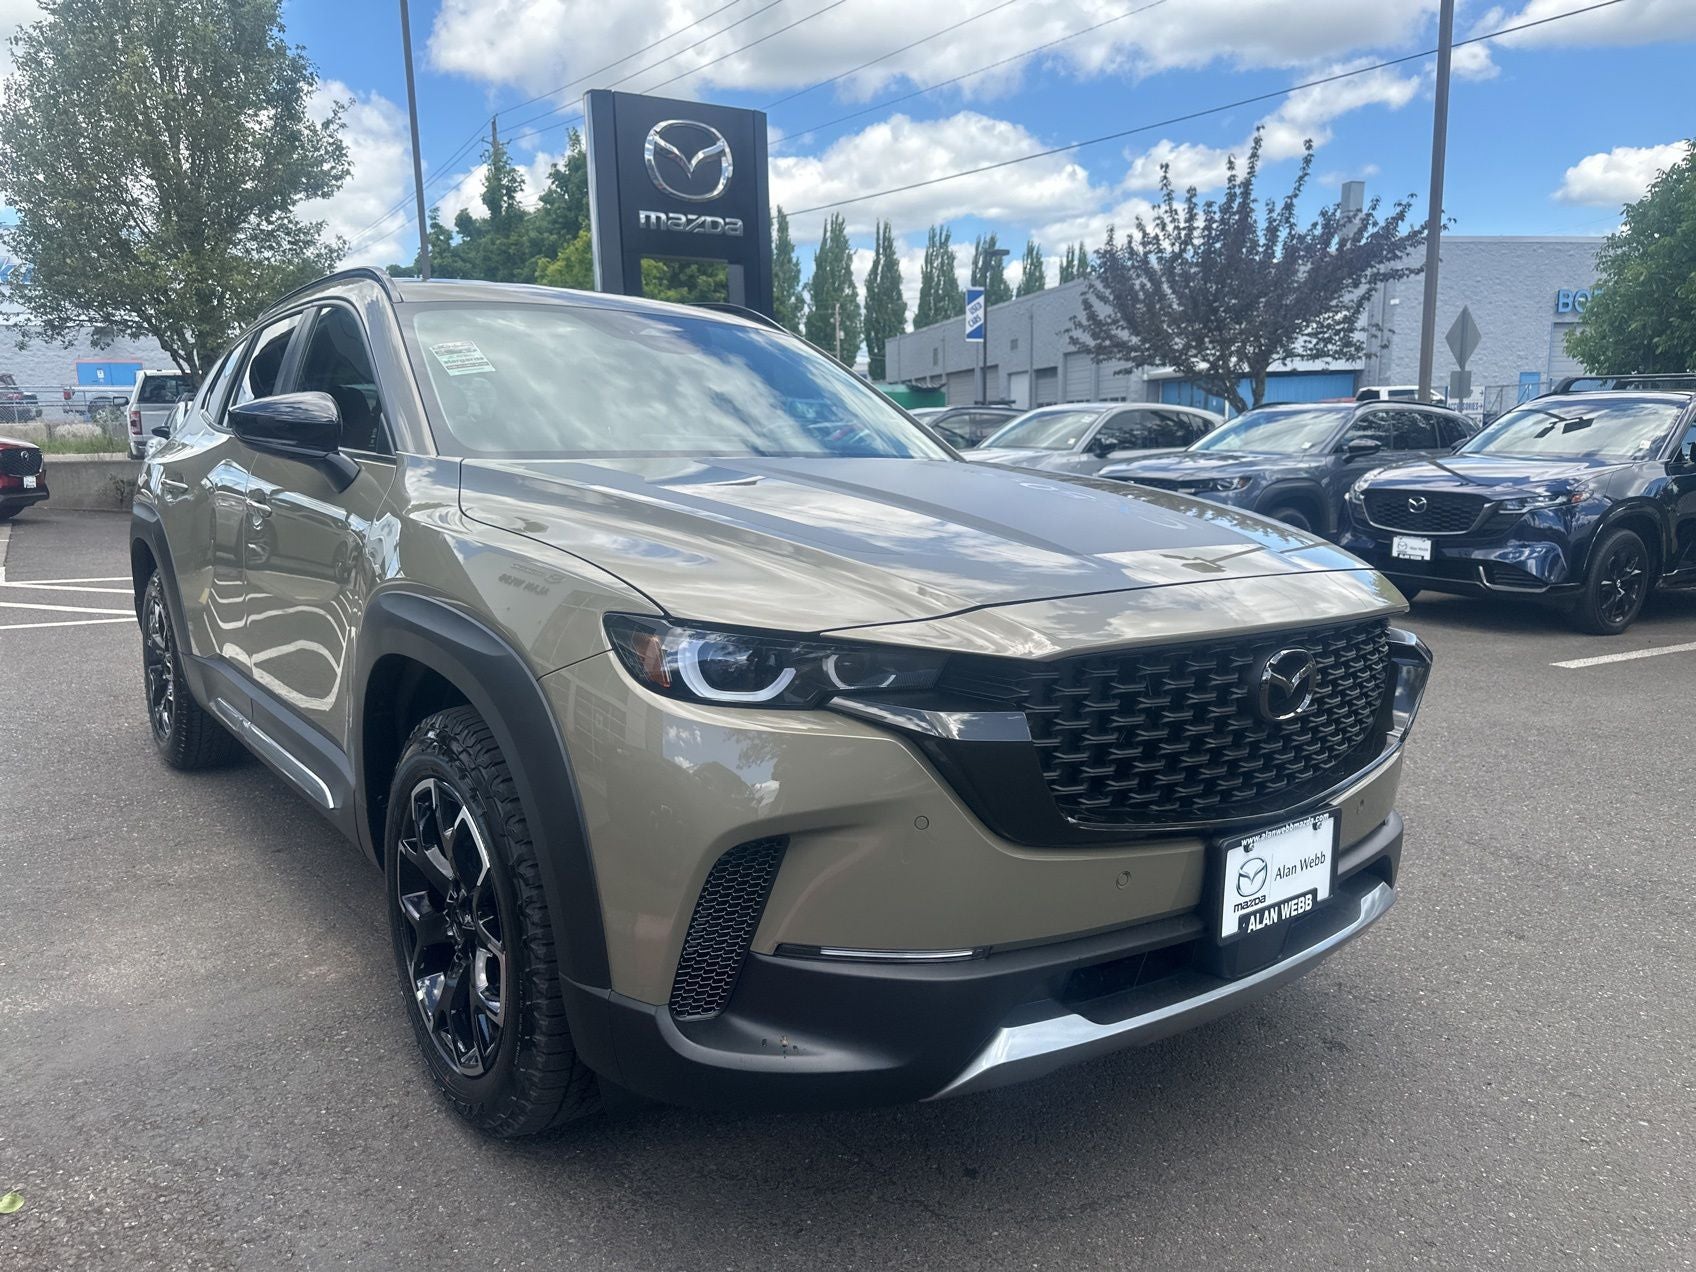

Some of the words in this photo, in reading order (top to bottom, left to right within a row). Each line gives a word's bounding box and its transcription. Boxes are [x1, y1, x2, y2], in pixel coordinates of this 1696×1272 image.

[1557, 288, 1604, 313] BO
[1274, 864, 1297, 881] Alan
[1299, 851, 1326, 872] Webb
[1247, 906, 1278, 933] ALAN
[1280, 893, 1313, 920] WEBB
